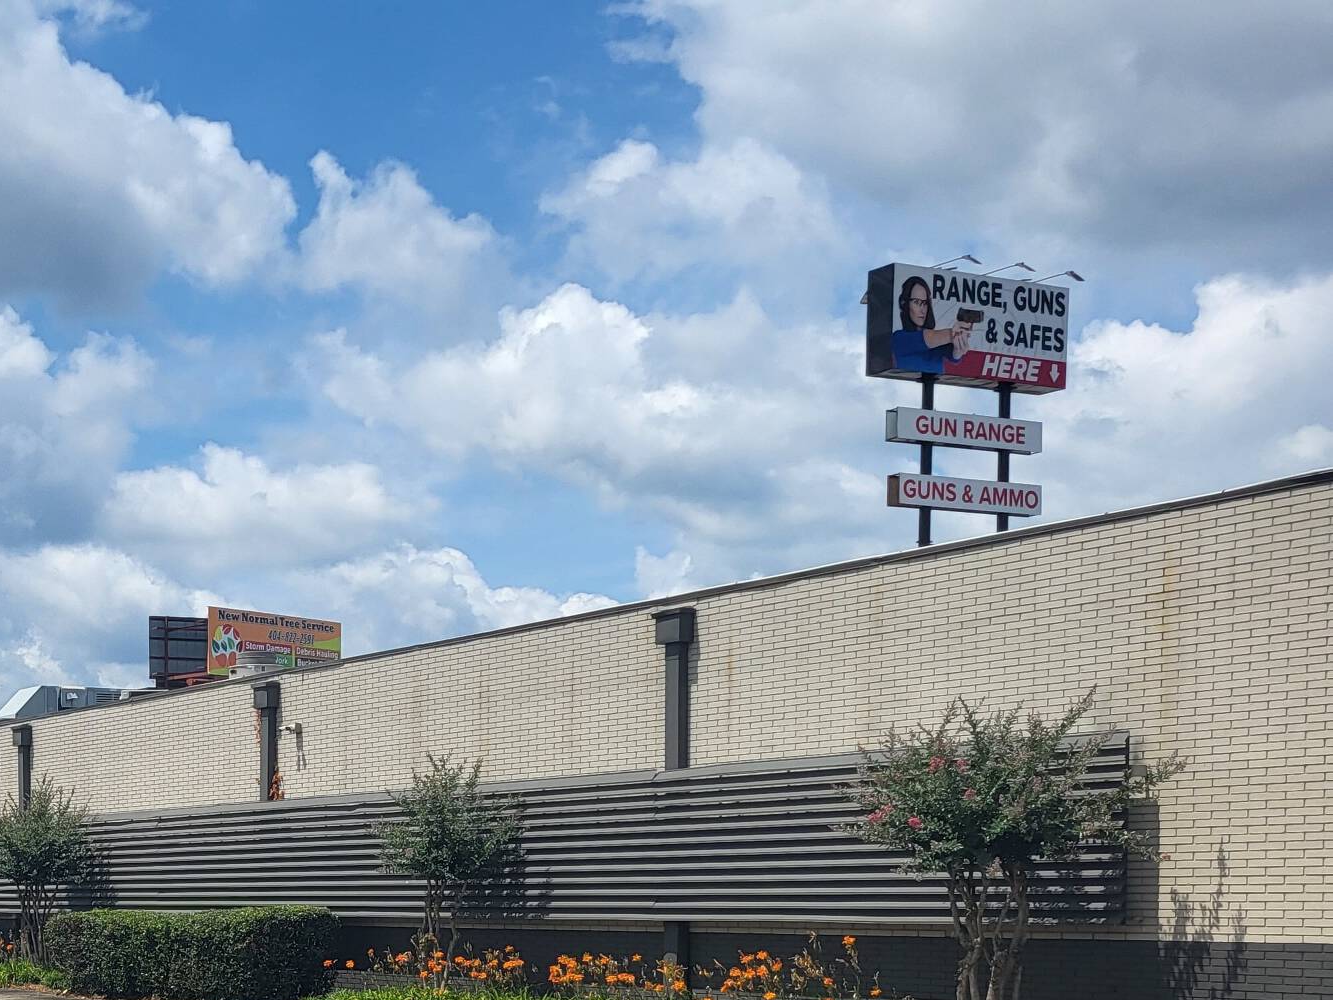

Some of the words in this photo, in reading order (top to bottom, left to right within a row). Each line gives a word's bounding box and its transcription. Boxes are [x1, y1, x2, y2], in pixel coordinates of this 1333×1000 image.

[932, 274, 1008, 313] RANGE,
[1013, 286, 1066, 317] GUNS
[985, 319, 998, 344] &
[1003, 322, 1065, 352] SAFES
[981, 355, 1040, 382] HERE
[916, 415, 957, 437] GUN
[963, 421, 1026, 444] RANGE
[903, 479, 956, 501] GUNS
[962, 484, 973, 504] &
[979, 486, 1039, 509] AMMO
[218, 610, 241, 621] New
[241, 612, 278, 625] Normal
[279, 617, 300, 629] Tree
[301, 620, 335, 633] Service
[246, 641, 265, 651] Storm
[266, 644, 291, 654] Damage
[296, 647, 315, 657] Debris
[316, 650, 339, 661] Hauling
